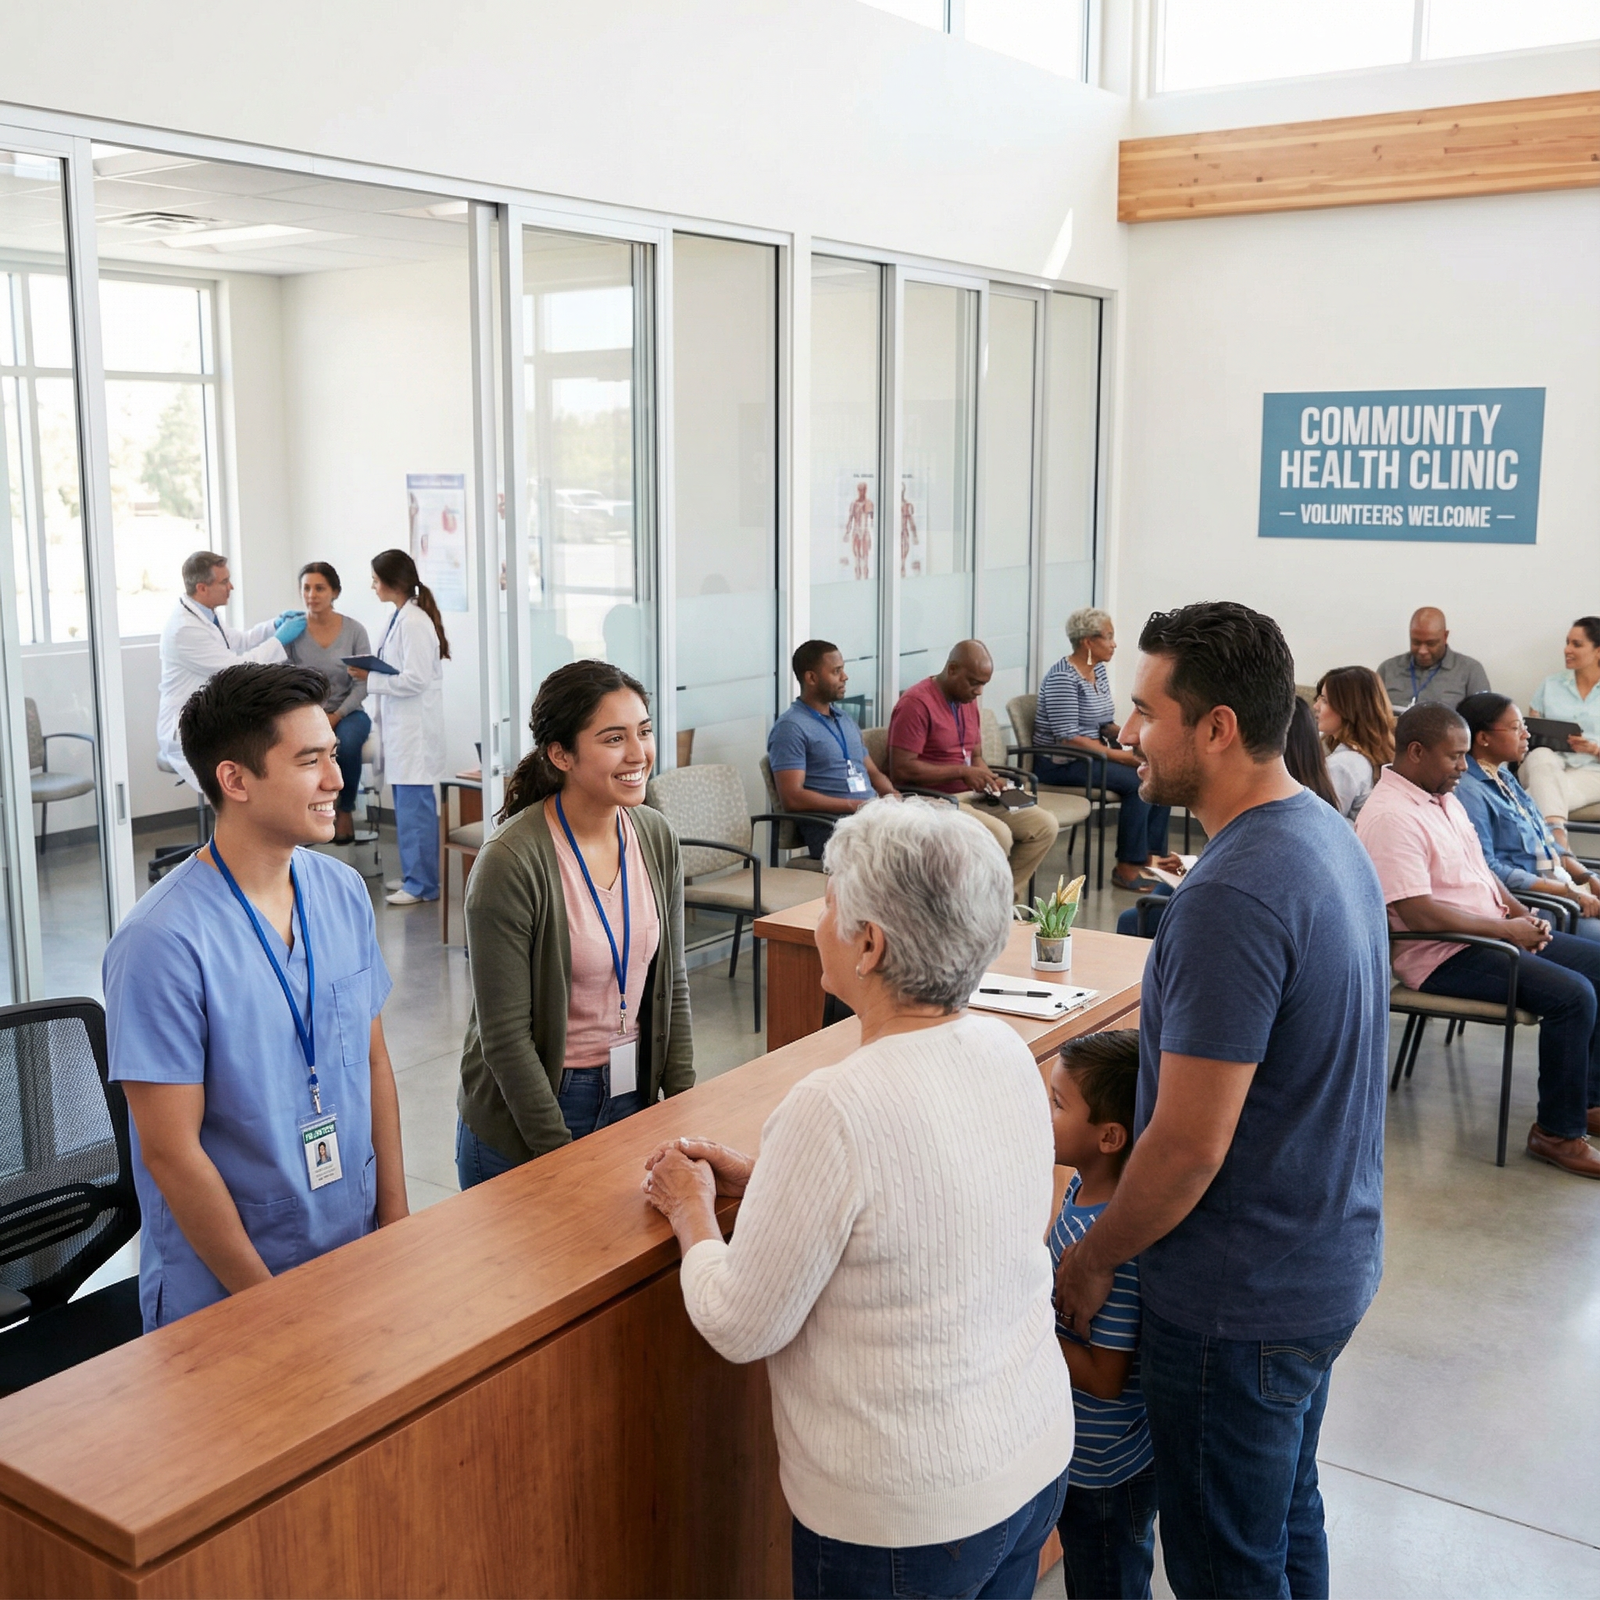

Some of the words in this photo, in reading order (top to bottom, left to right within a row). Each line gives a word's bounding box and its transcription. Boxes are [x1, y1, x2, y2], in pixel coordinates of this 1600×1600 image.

[1300, 403, 1502, 446] COMMUNITY
[1280, 449, 1400, 490] HEALTH
[1409, 448, 1519, 491] CLINIC
[1300, 503, 1404, 527] VOLUNTEERS
[1407, 505, 1492, 528] WELCOME
